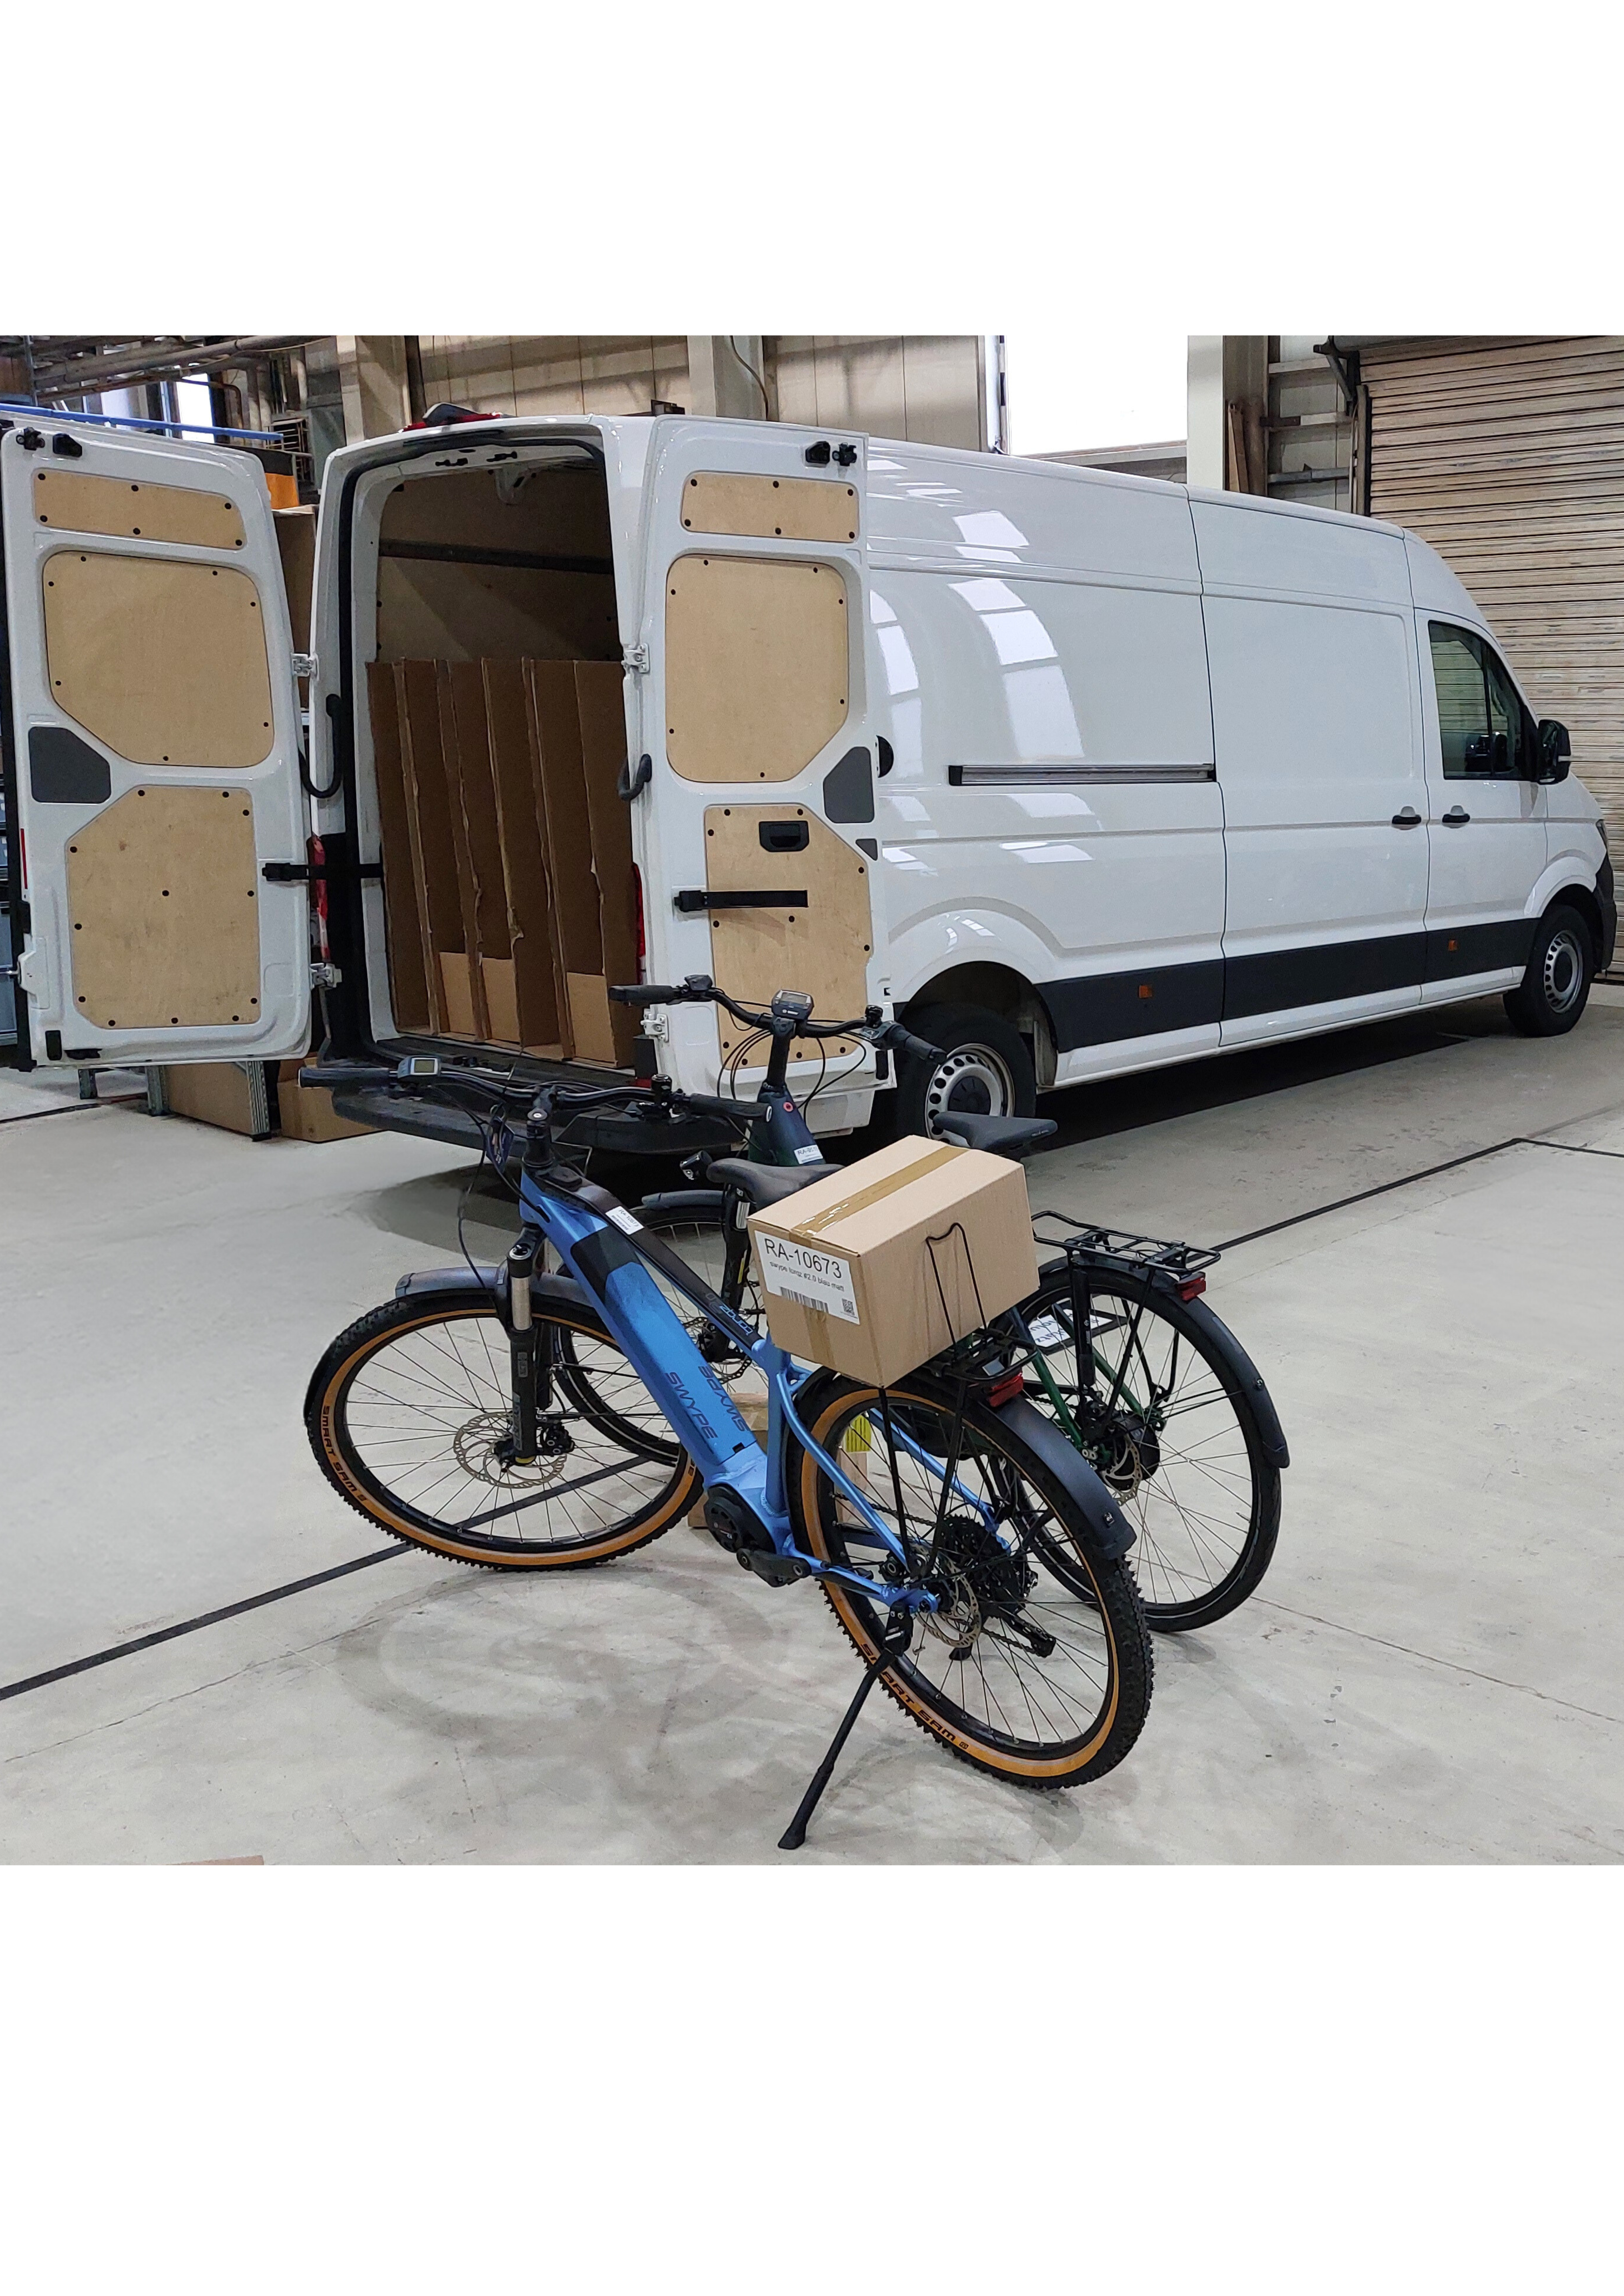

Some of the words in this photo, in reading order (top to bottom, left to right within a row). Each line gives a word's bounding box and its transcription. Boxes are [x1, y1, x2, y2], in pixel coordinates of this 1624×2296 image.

[764, 1238, 842, 1279] RA-10673
[665, 1372, 719, 1439] SWYPE
[698, 1366, 752, 1432] SWYPE
[322, 1405, 336, 1457] SMART
[333, 1461, 358, 1492] SAM
[861, 1644, 915, 1705] SART
[917, 1709, 956, 1741] SAM
